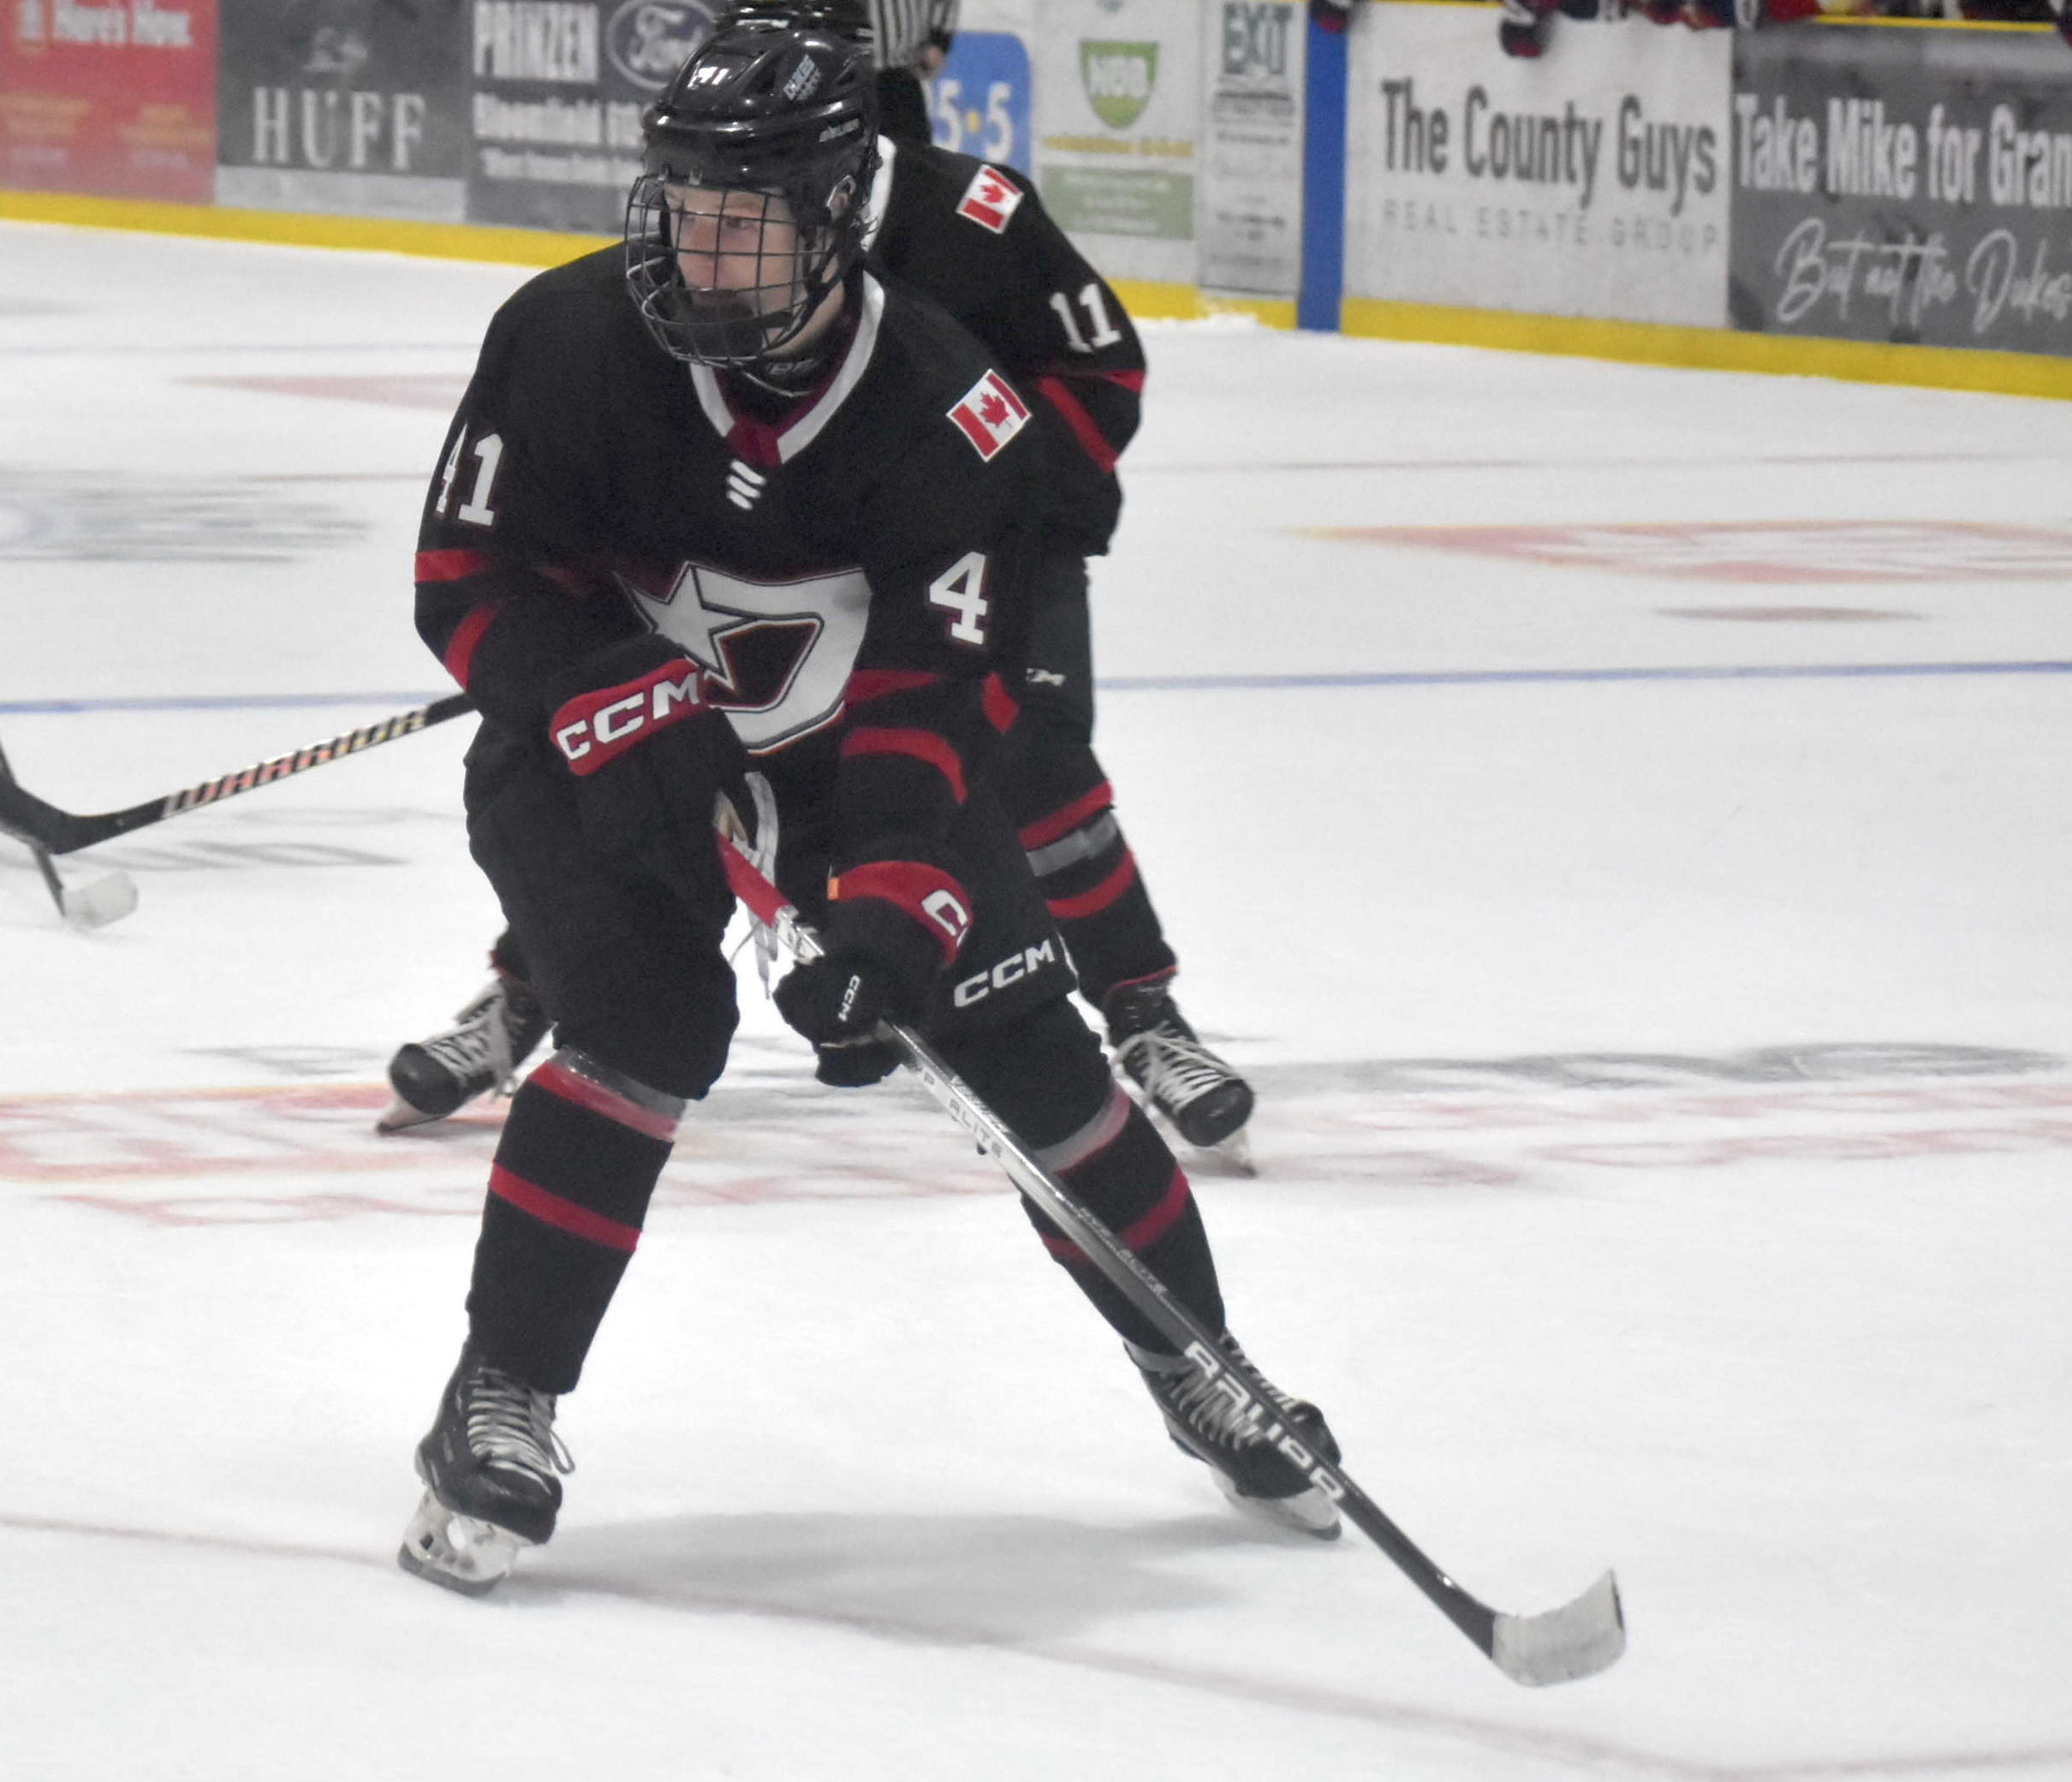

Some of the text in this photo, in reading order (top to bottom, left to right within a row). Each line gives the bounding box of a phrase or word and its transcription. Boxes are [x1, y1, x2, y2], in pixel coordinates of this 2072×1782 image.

[252, 86, 427, 169] HUFF
[1381, 77, 1716, 218] The County Guys
[1736, 93, 1819, 194] Take
[1827, 97, 1918, 200] Mike
[1926, 102, 1982, 206] for
[1383, 198, 1458, 235] REAL
[1475, 206, 1588, 246] ESTATE
[1049, 283, 1122, 352] 11
[436, 423, 504, 527] 41
[929, 551, 987, 645] 4
[557, 671, 700, 760] CCM
[838, 974, 860, 1022] CCM
[954, 939, 1056, 1008] CCM
